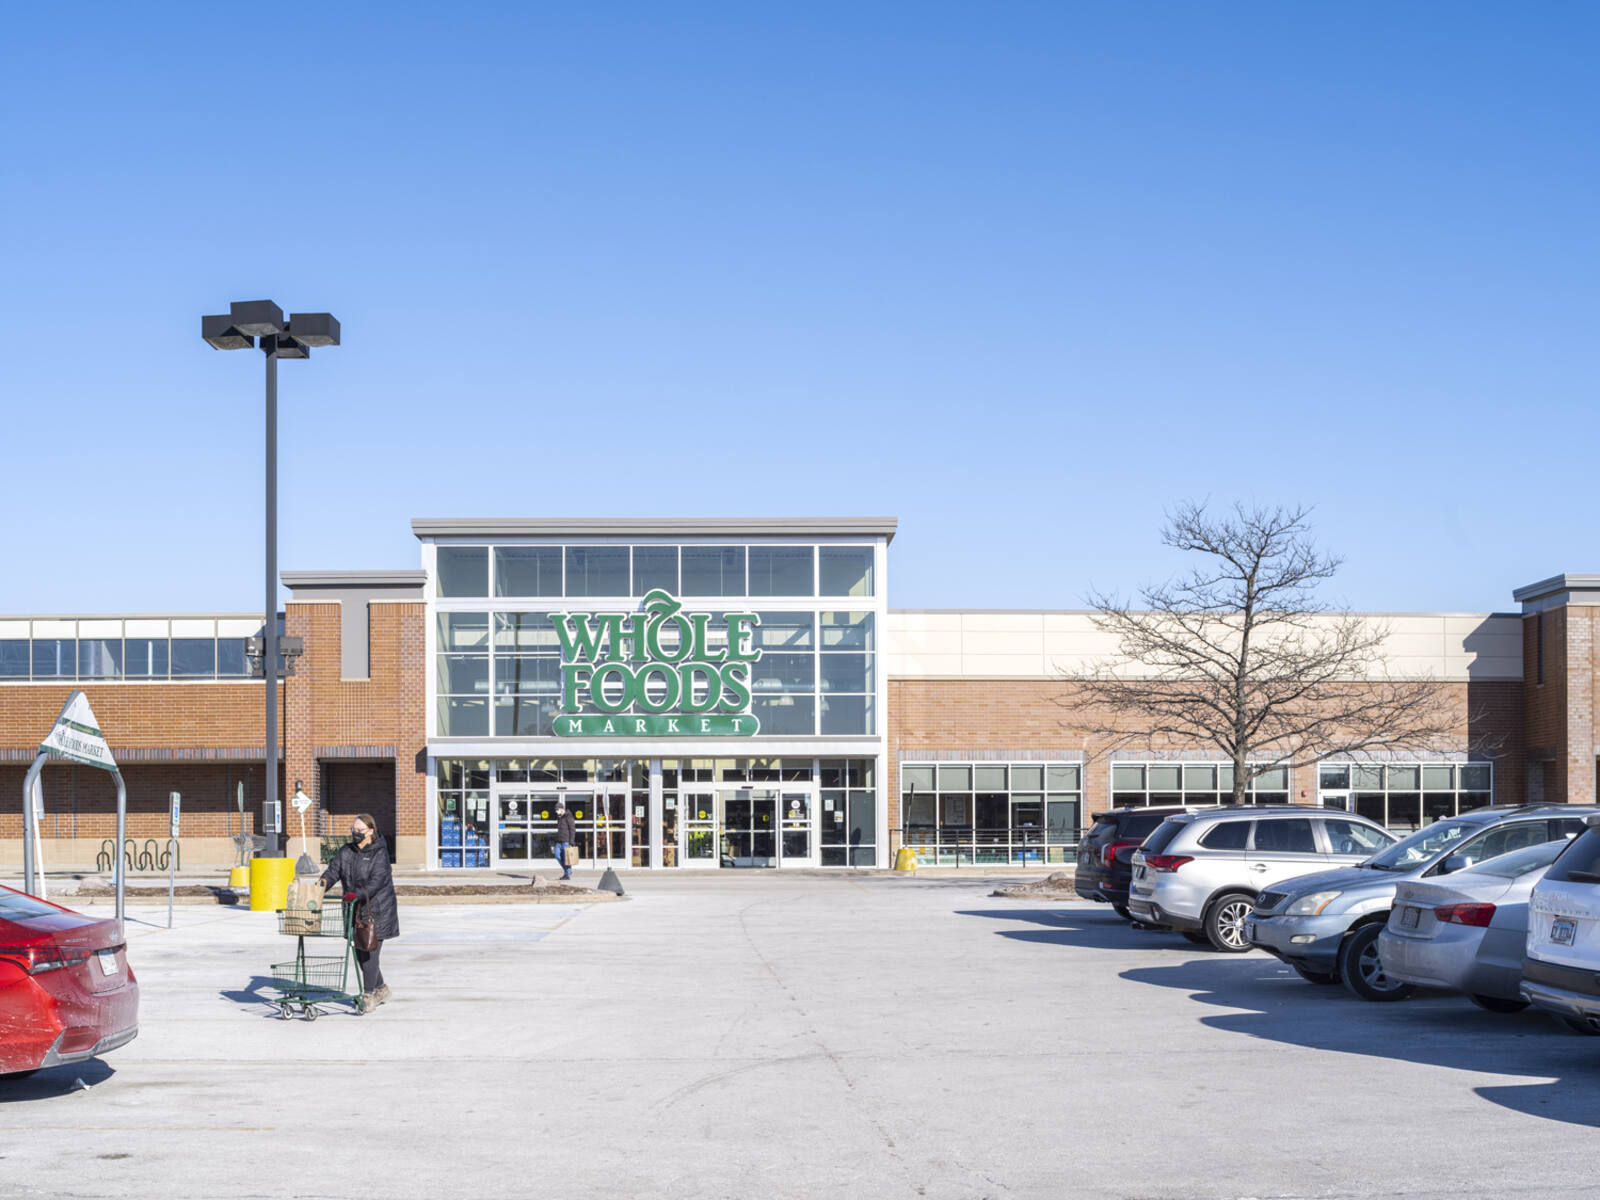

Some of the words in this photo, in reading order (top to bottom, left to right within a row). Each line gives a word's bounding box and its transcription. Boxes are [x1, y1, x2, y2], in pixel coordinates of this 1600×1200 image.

[547, 610, 762, 663] WHOLE
[560, 662, 751, 712] FOODS
[568, 718, 743, 733] MARKET
[82, 743, 104, 758] MARKET
